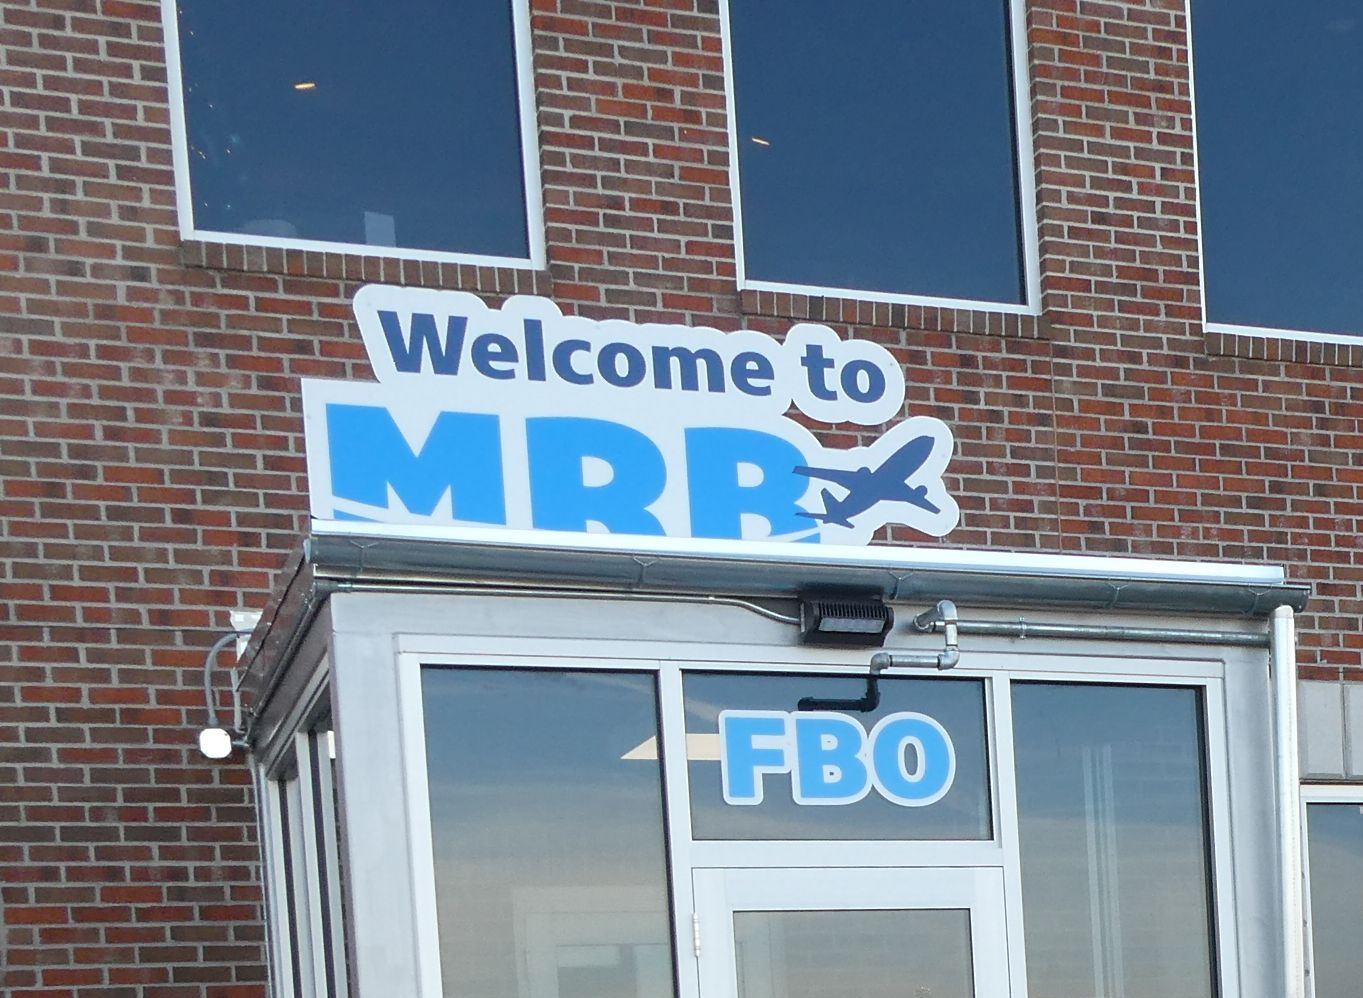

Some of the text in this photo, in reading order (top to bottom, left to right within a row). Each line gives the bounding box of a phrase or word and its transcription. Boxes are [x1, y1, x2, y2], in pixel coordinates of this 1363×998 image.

[377, 310, 887, 403] Welcome to
[325, 402, 821, 544] MRB
[722, 713, 953, 804] FBO
